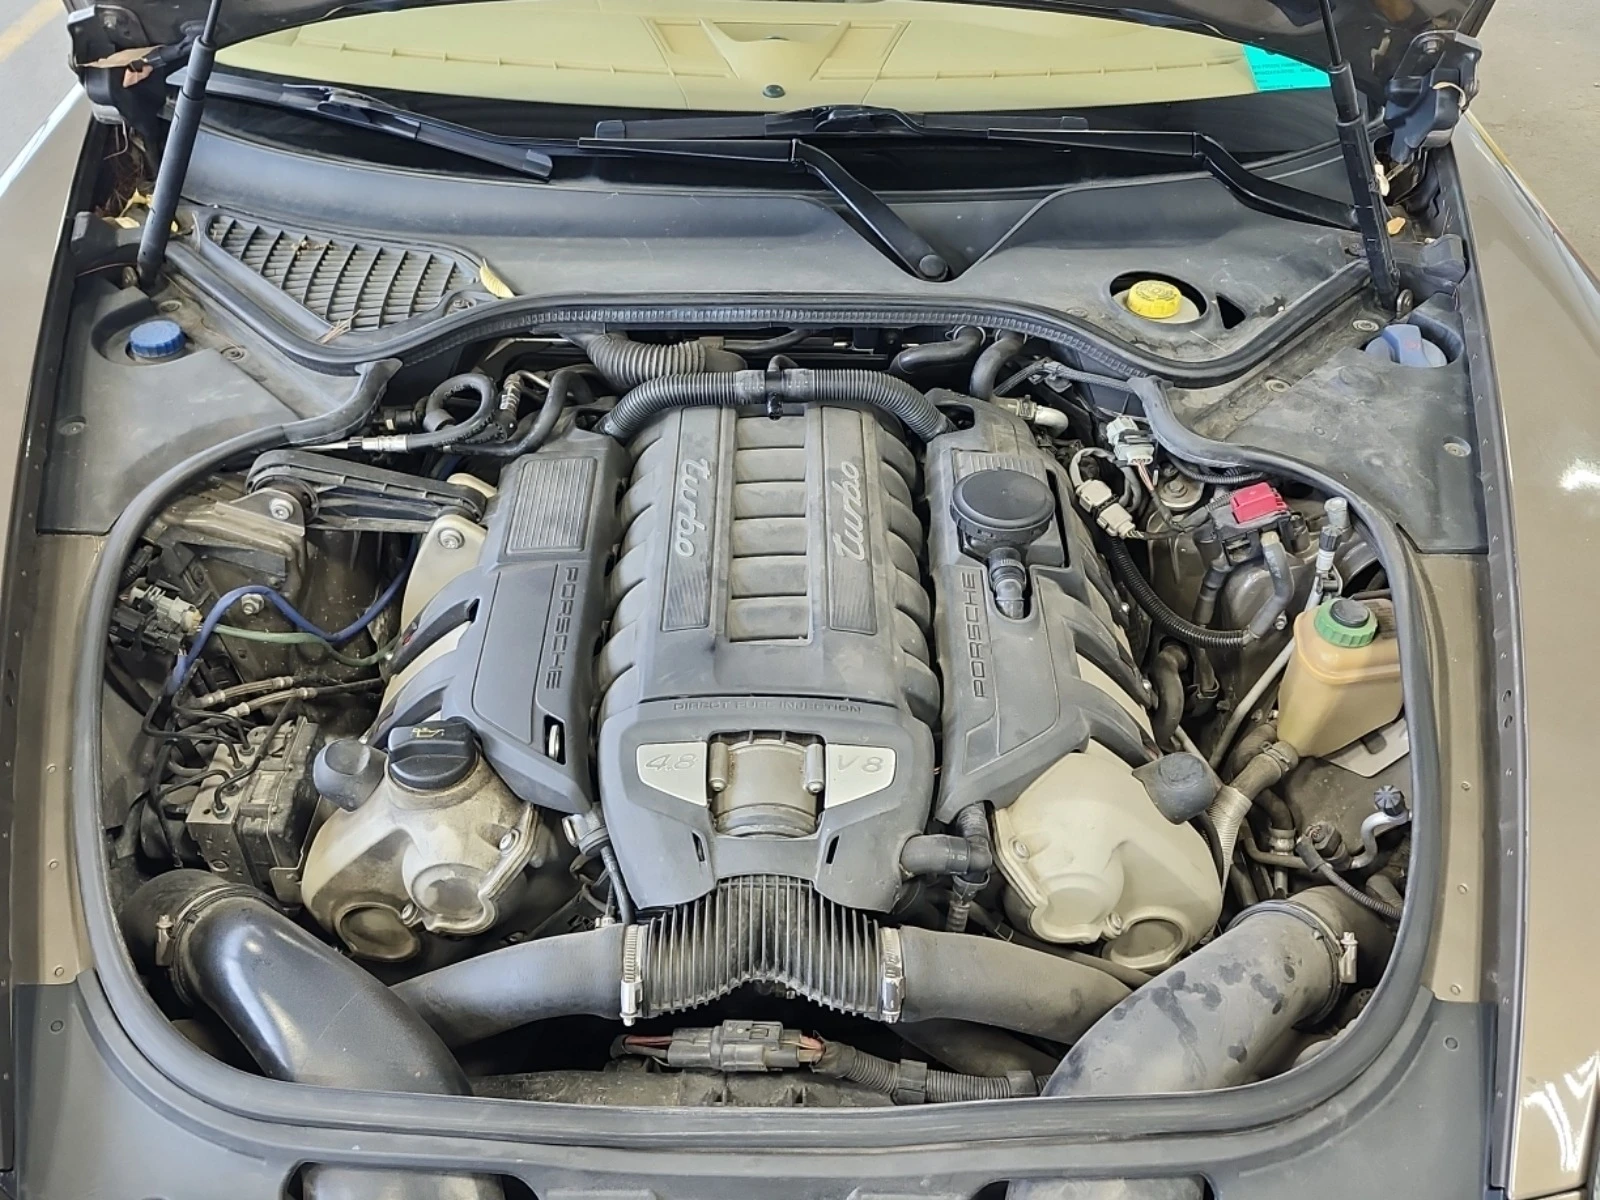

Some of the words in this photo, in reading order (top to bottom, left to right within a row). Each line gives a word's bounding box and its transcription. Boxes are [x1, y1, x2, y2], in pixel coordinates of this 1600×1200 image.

[674, 458, 711, 558] turbo
[832, 460, 865, 561] turbo
[546, 567, 578, 689] PORSCHE
[962, 572, 988, 698] PORSCHE
[673, 701, 731, 711] DIRECT
[735, 701, 774, 709] FUEL
[779, 701, 861, 713] INJECTION
[645, 753, 698, 772] 4.8
